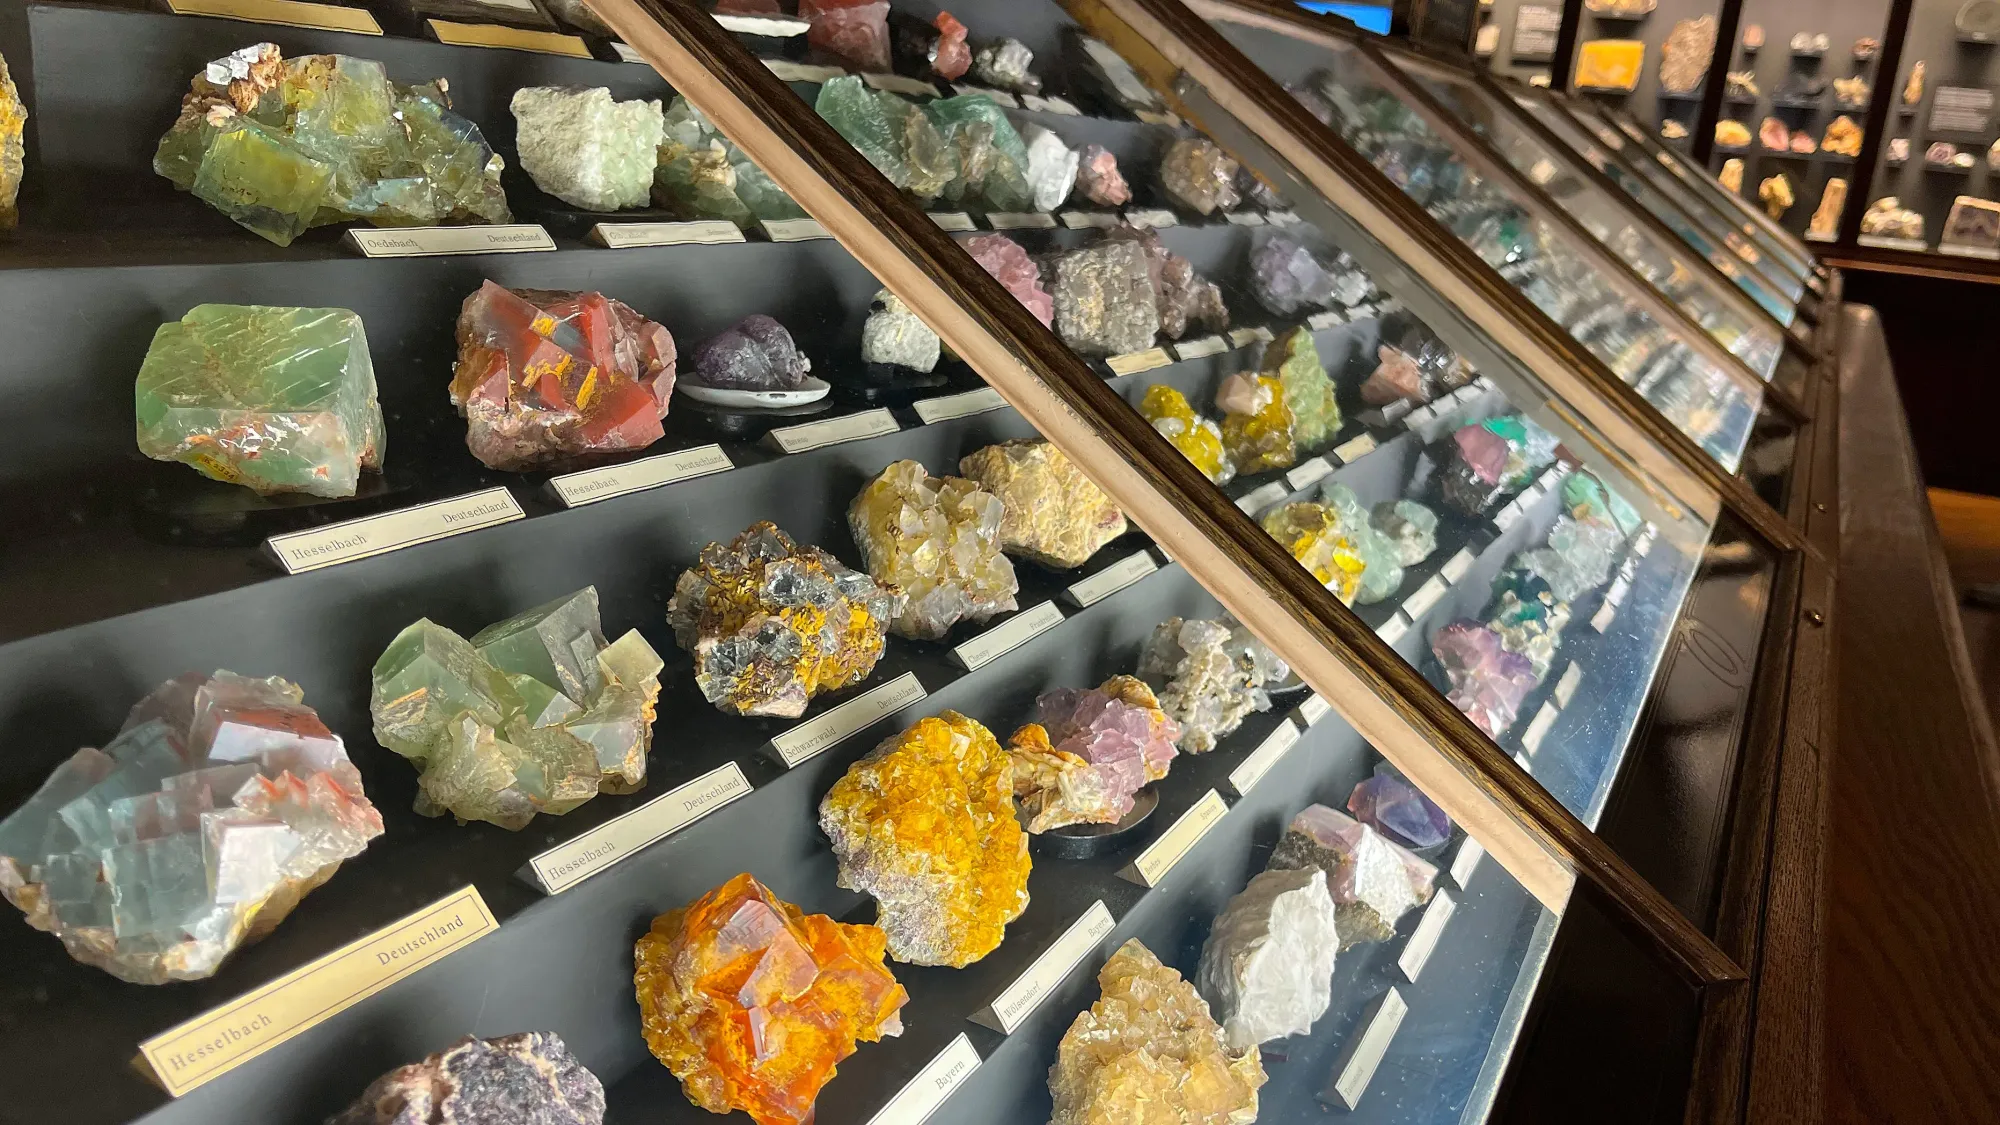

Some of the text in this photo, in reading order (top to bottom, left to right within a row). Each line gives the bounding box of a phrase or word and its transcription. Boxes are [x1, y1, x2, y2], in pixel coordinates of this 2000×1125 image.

[367, 232, 541, 249] Oedsbach Deutschland
[564, 455, 725, 497] Hesselbach Deutschland
[291, 500, 510, 560] Hesselbach Deutschland
[785, 684, 918, 758] Schwarzwald Deutschland
[548, 777, 741, 881] Hesselbach Deutschland
[169, 914, 465, 1073] Hesselbach Deutschland
[1003, 916, 1109, 1019] Wölsendorf Bayern
[934, 1059, 966, 1091] Bayern
